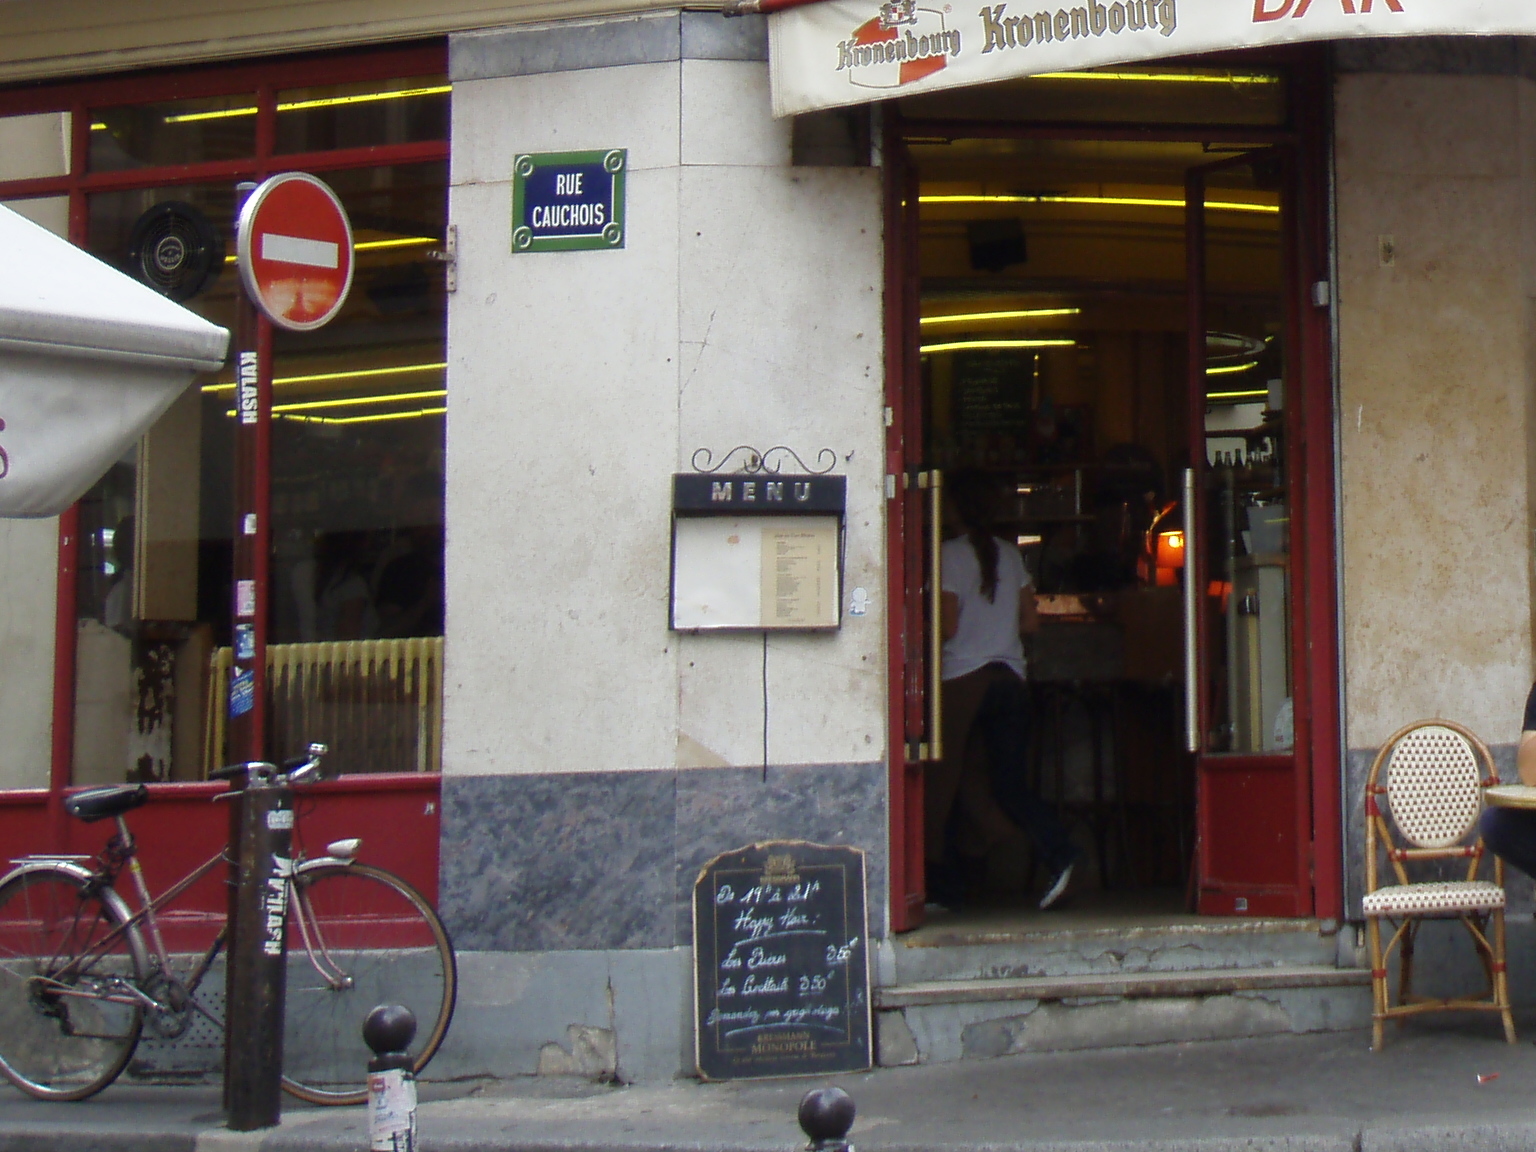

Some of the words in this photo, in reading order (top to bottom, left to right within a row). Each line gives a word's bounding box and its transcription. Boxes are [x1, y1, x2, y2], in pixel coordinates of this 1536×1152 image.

[835, 29, 961, 71] Kronenbourg
[556, 173, 583, 195] RUE
[532, 202, 605, 228] CAUCHOIS
[711, 481, 811, 502] MENU
